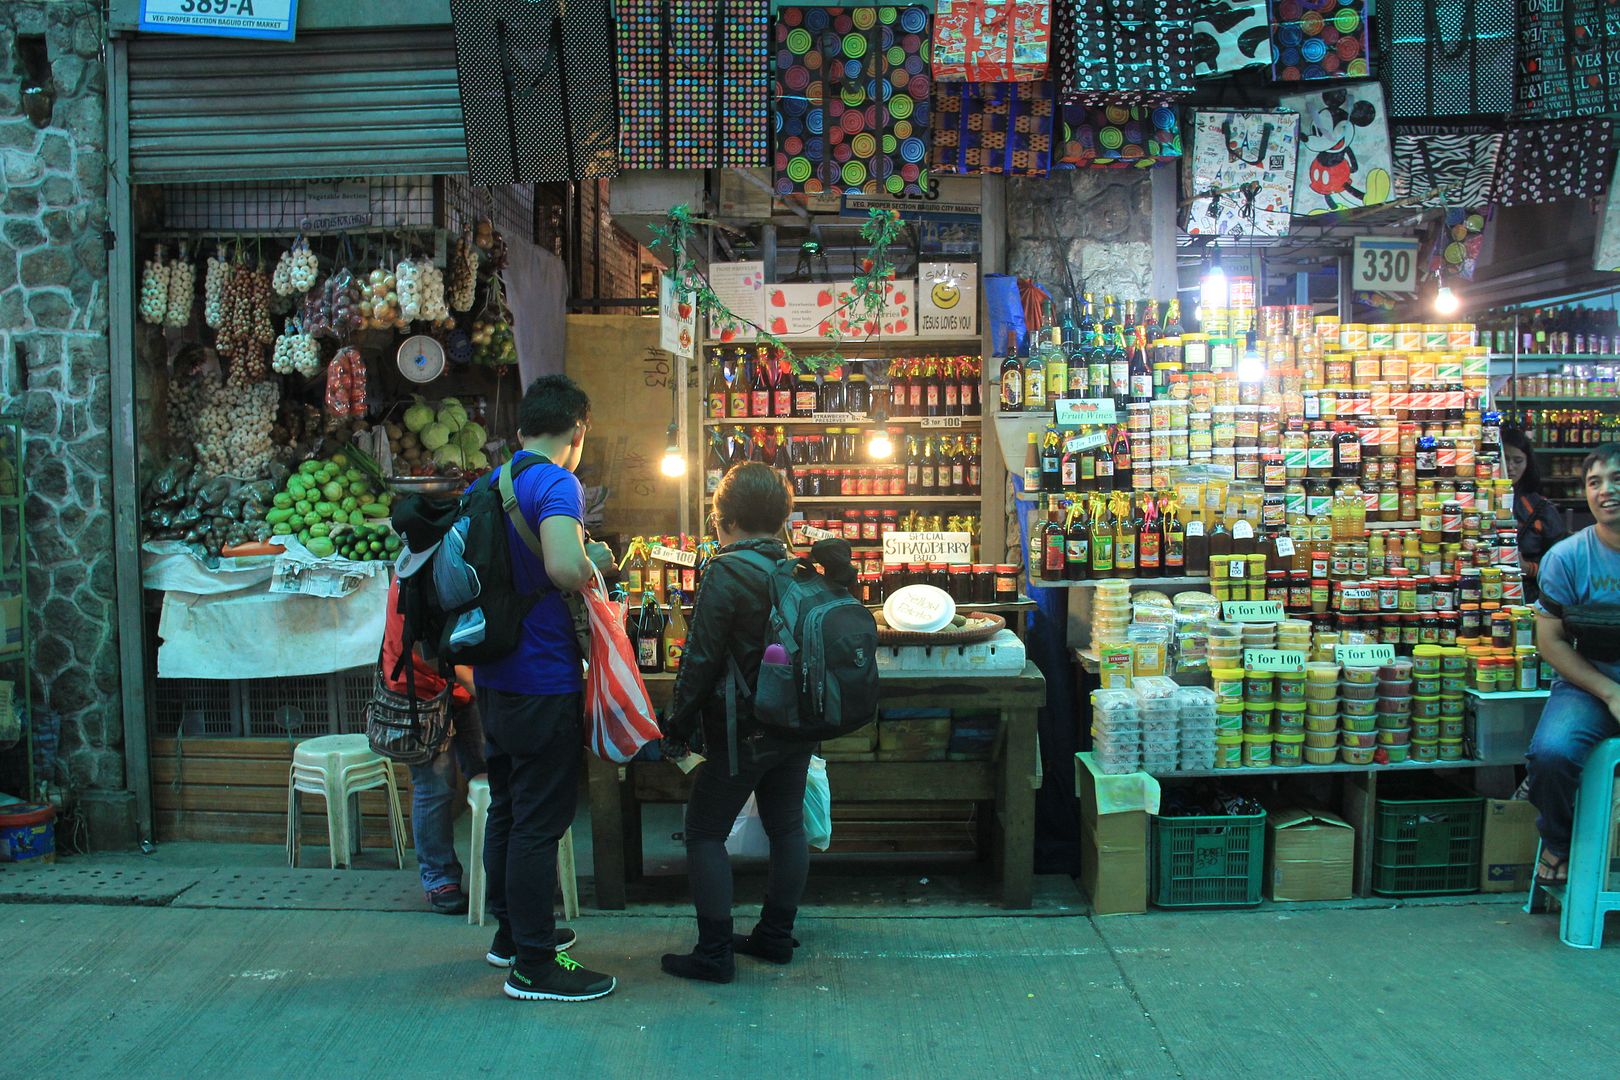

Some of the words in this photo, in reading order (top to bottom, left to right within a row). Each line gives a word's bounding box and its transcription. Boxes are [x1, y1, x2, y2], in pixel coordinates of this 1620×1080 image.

[166, 16, 191, 24] PROPER
[192, 17, 217, 25] SECTION
[217, 18, 242, 26] BAGUIO
[256, 21, 281, 29] MARKET
[891, 203, 917, 211] SECTION
[917, 204, 940, 212] BAGUIO
[941, 204, 954, 212] CITY
[955, 205, 979, 213] MARKET
[1362, 250, 1410, 282] 330
[924, 269, 969, 281] SMILE
[922, 315, 940, 330] JESUS
[940, 315, 958, 330] LOVES
[922, 418, 930, 426] 3
[943, 417, 961, 427] 100
[1061, 411, 1084, 421] Fruit
[1086, 411, 1113, 420] Wines
[909, 532, 945, 541] SPECIAL
[885, 538, 971, 555] STRAWBERRY
[653, 546, 662, 556] 3
[676, 552, 695, 565] 100
[1228, 606, 1235, 615] 6
[1237, 606, 1256, 616] for
[1258, 604, 1279, 615] 100
[1246, 653, 1253, 663] 3
[1257, 653, 1276, 664] for
[1280, 654, 1301, 665] 100
[1337, 650, 1344, 660] 5
[1347, 649, 1366, 659] for
[1370, 648, 1391, 659] 100
